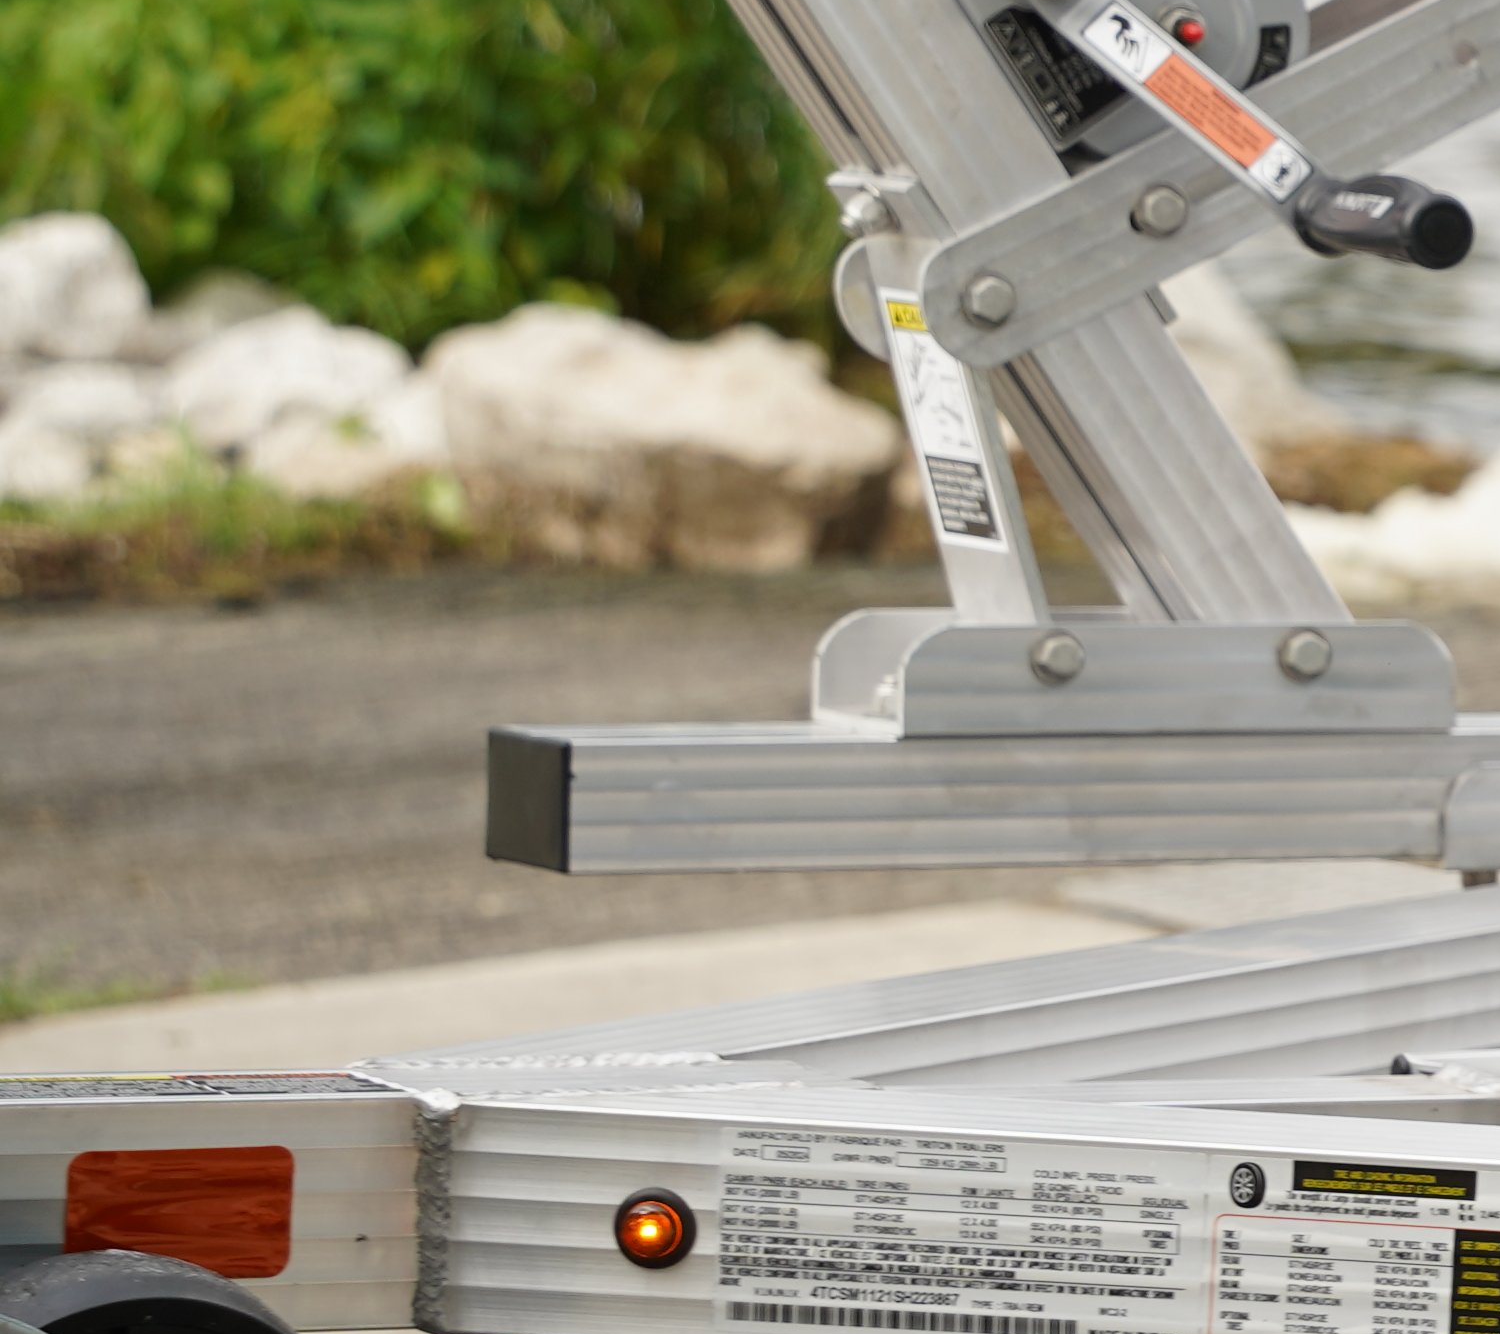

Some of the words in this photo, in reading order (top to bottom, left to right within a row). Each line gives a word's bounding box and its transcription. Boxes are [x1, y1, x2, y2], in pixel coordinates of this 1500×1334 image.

[733, 1147, 758, 1158] DATE
[917, 1140, 952, 1150] TRITON
[956, 1142, 1005, 1153] TRAILERS
[810, 1287, 960, 1306] 4TCSM1121SH223867
